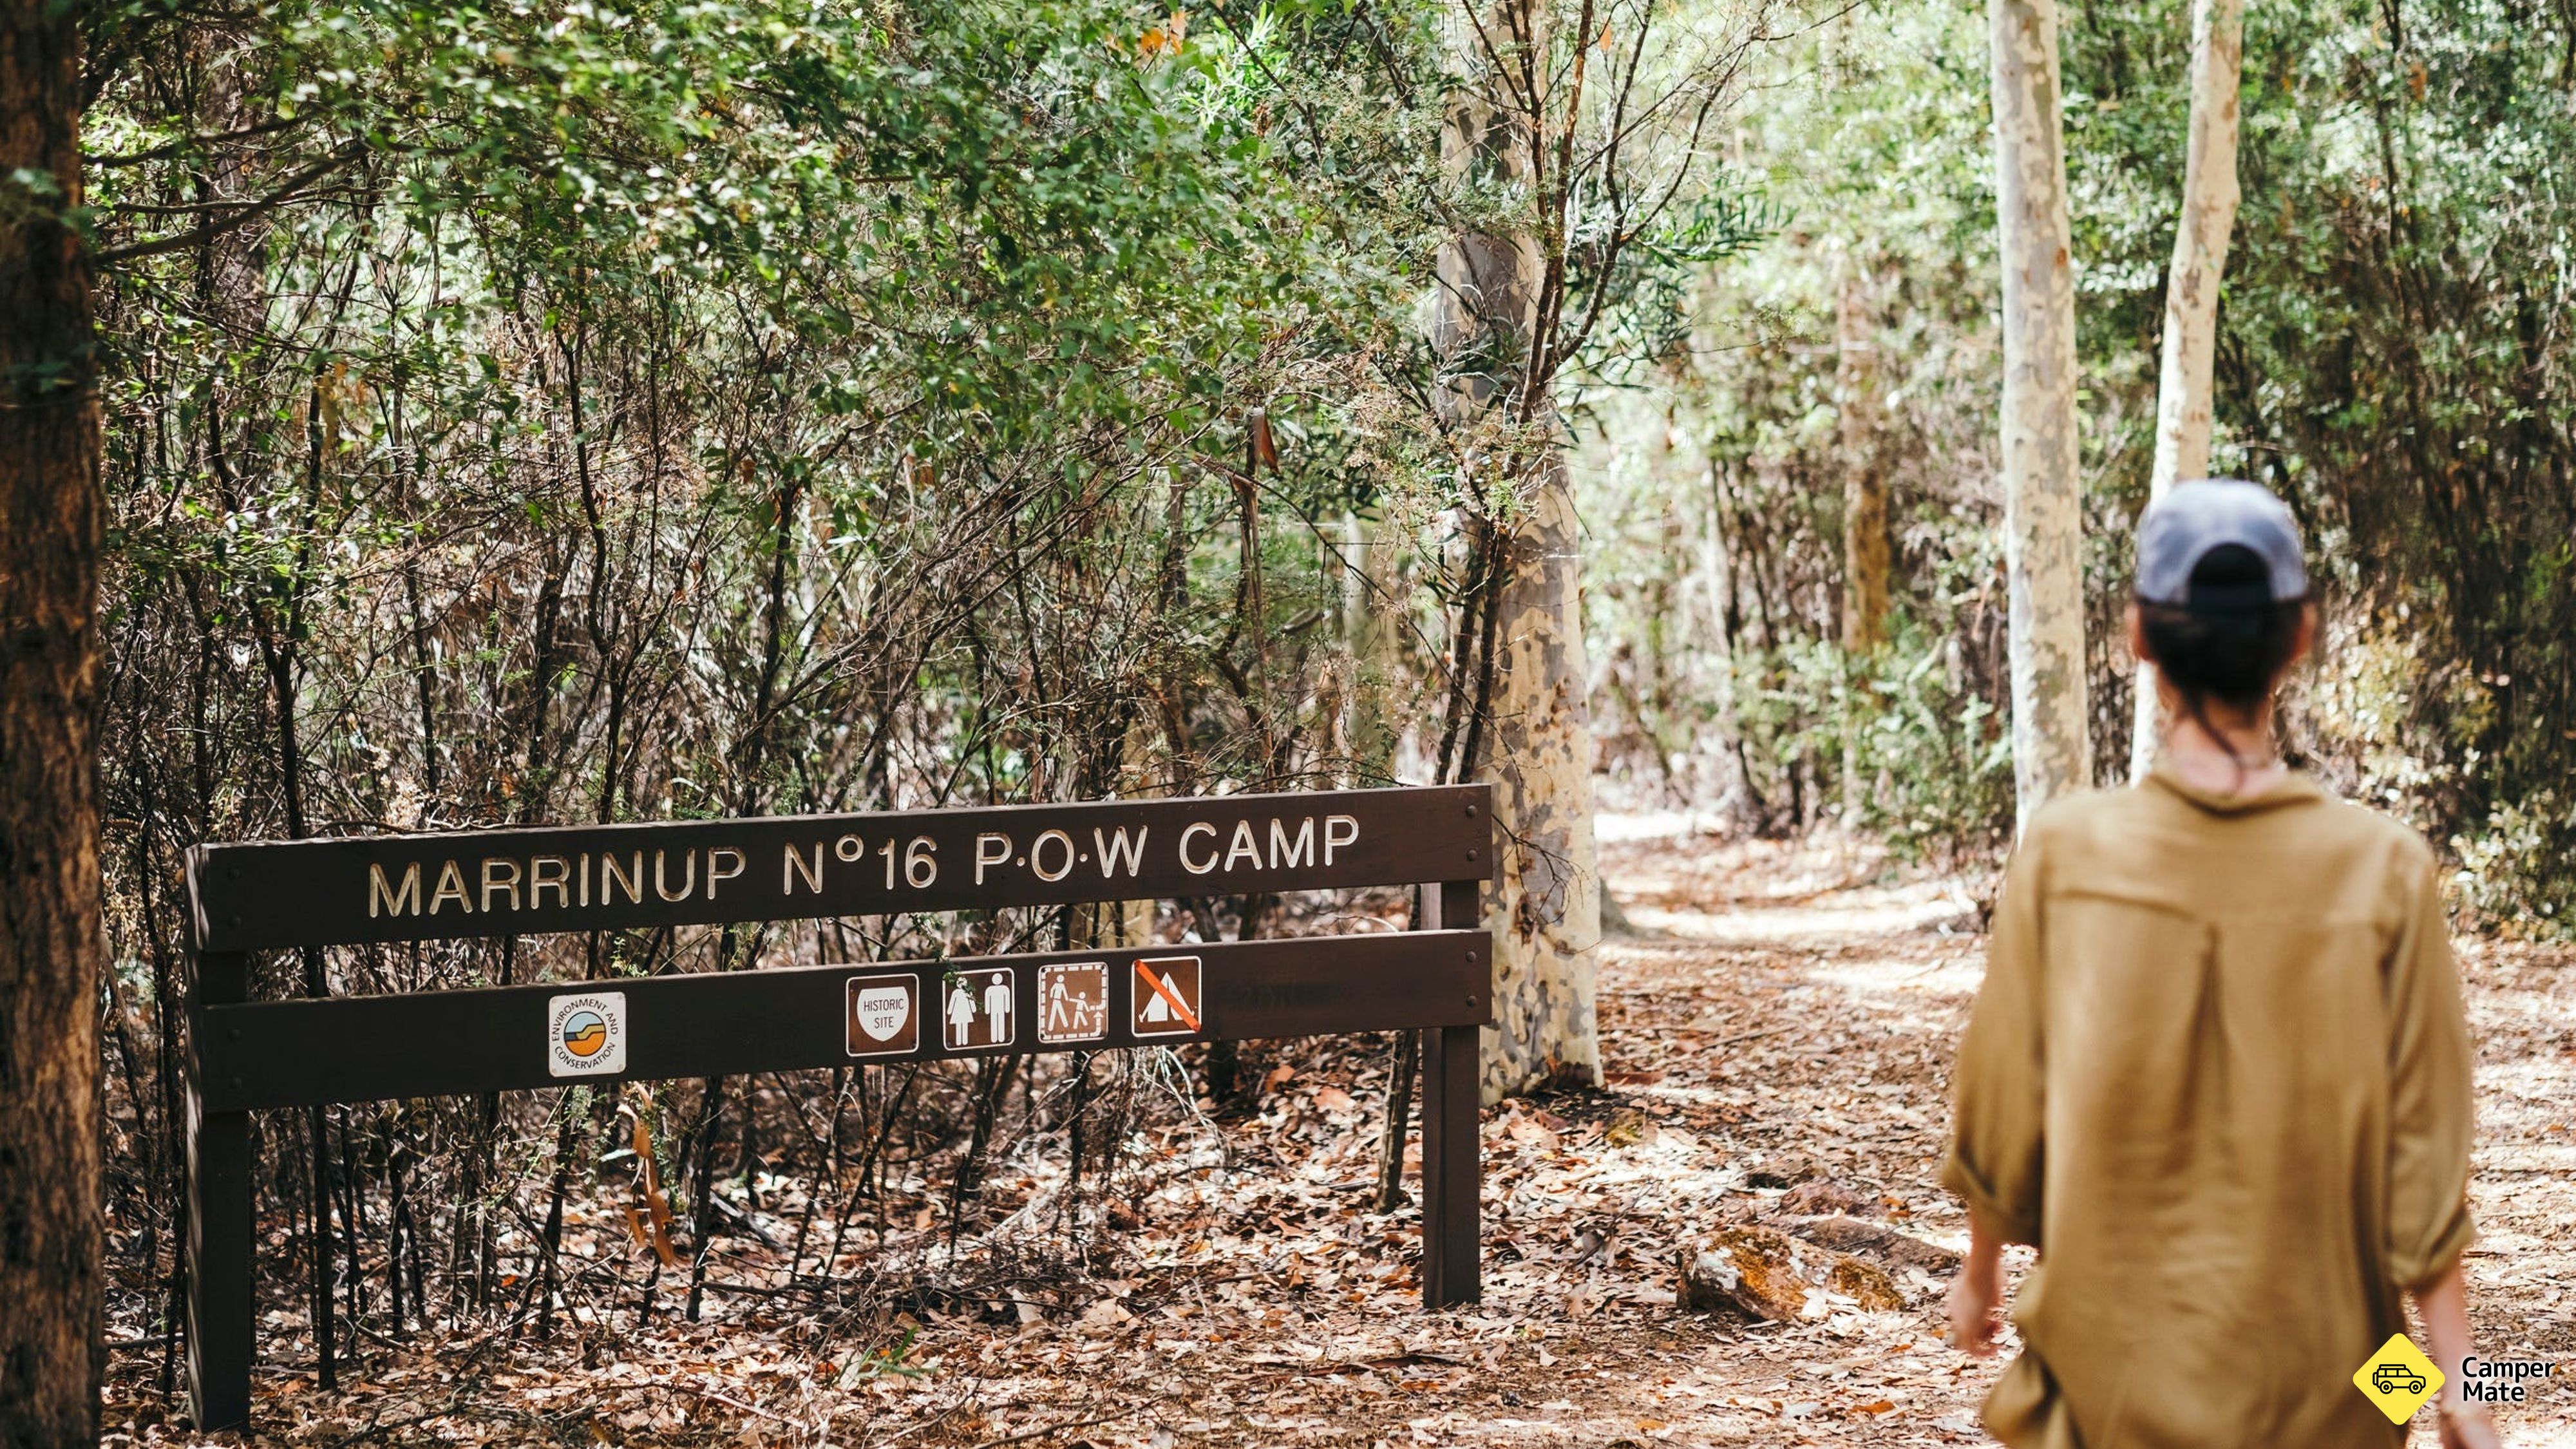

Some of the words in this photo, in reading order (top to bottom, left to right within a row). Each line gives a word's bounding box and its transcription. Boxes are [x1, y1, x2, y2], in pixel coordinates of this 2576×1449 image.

[369, 846, 746, 918] MARRINUP
[1179, 815, 1359, 874] CAMP
[864, 998, 904, 1012] HISTORIC
[552, 998, 608, 1041] ENVIRONMENT
[606, 1012, 618, 1034] AND
[875, 1016, 894, 1028] SITE
[555, 1042, 616, 1069] CONSERVATION
